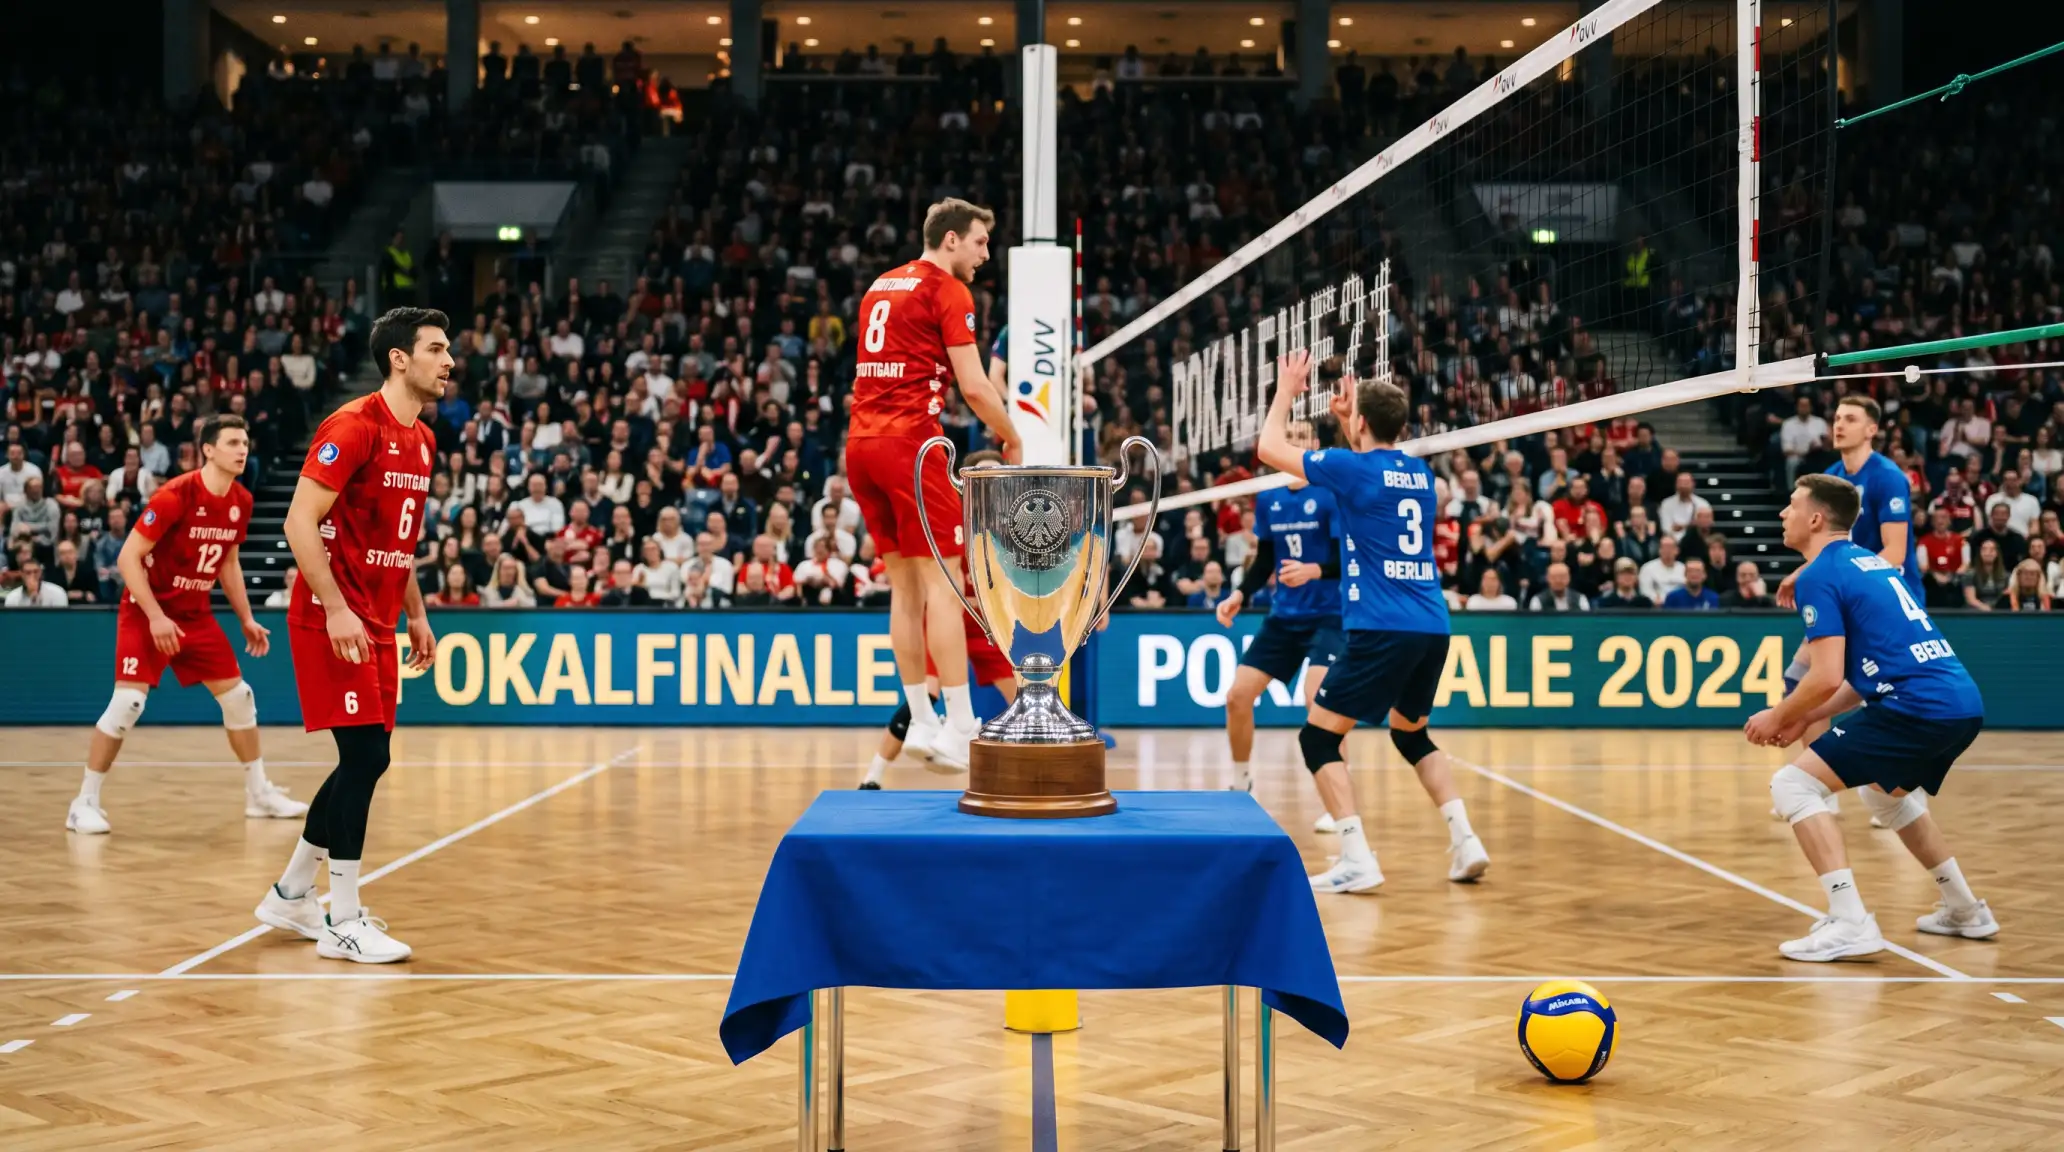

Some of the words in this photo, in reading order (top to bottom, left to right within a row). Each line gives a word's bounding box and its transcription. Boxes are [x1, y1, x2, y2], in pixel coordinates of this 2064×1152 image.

[865, 300, 891, 352] 8
[1034, 318, 1055, 376] DVV
[1383, 470, 1429, 490] BERLIN
[398, 497, 415, 540] 6
[1397, 498, 1423, 556] 3
[196, 543, 222, 574] 12
[1384, 560, 1434, 580] BERLIN
[1887, 576, 1933, 632] 4
[122, 656, 138, 675] 12
[1598, 635, 1786, 708] 2024
[344, 691, 358, 714] 6
